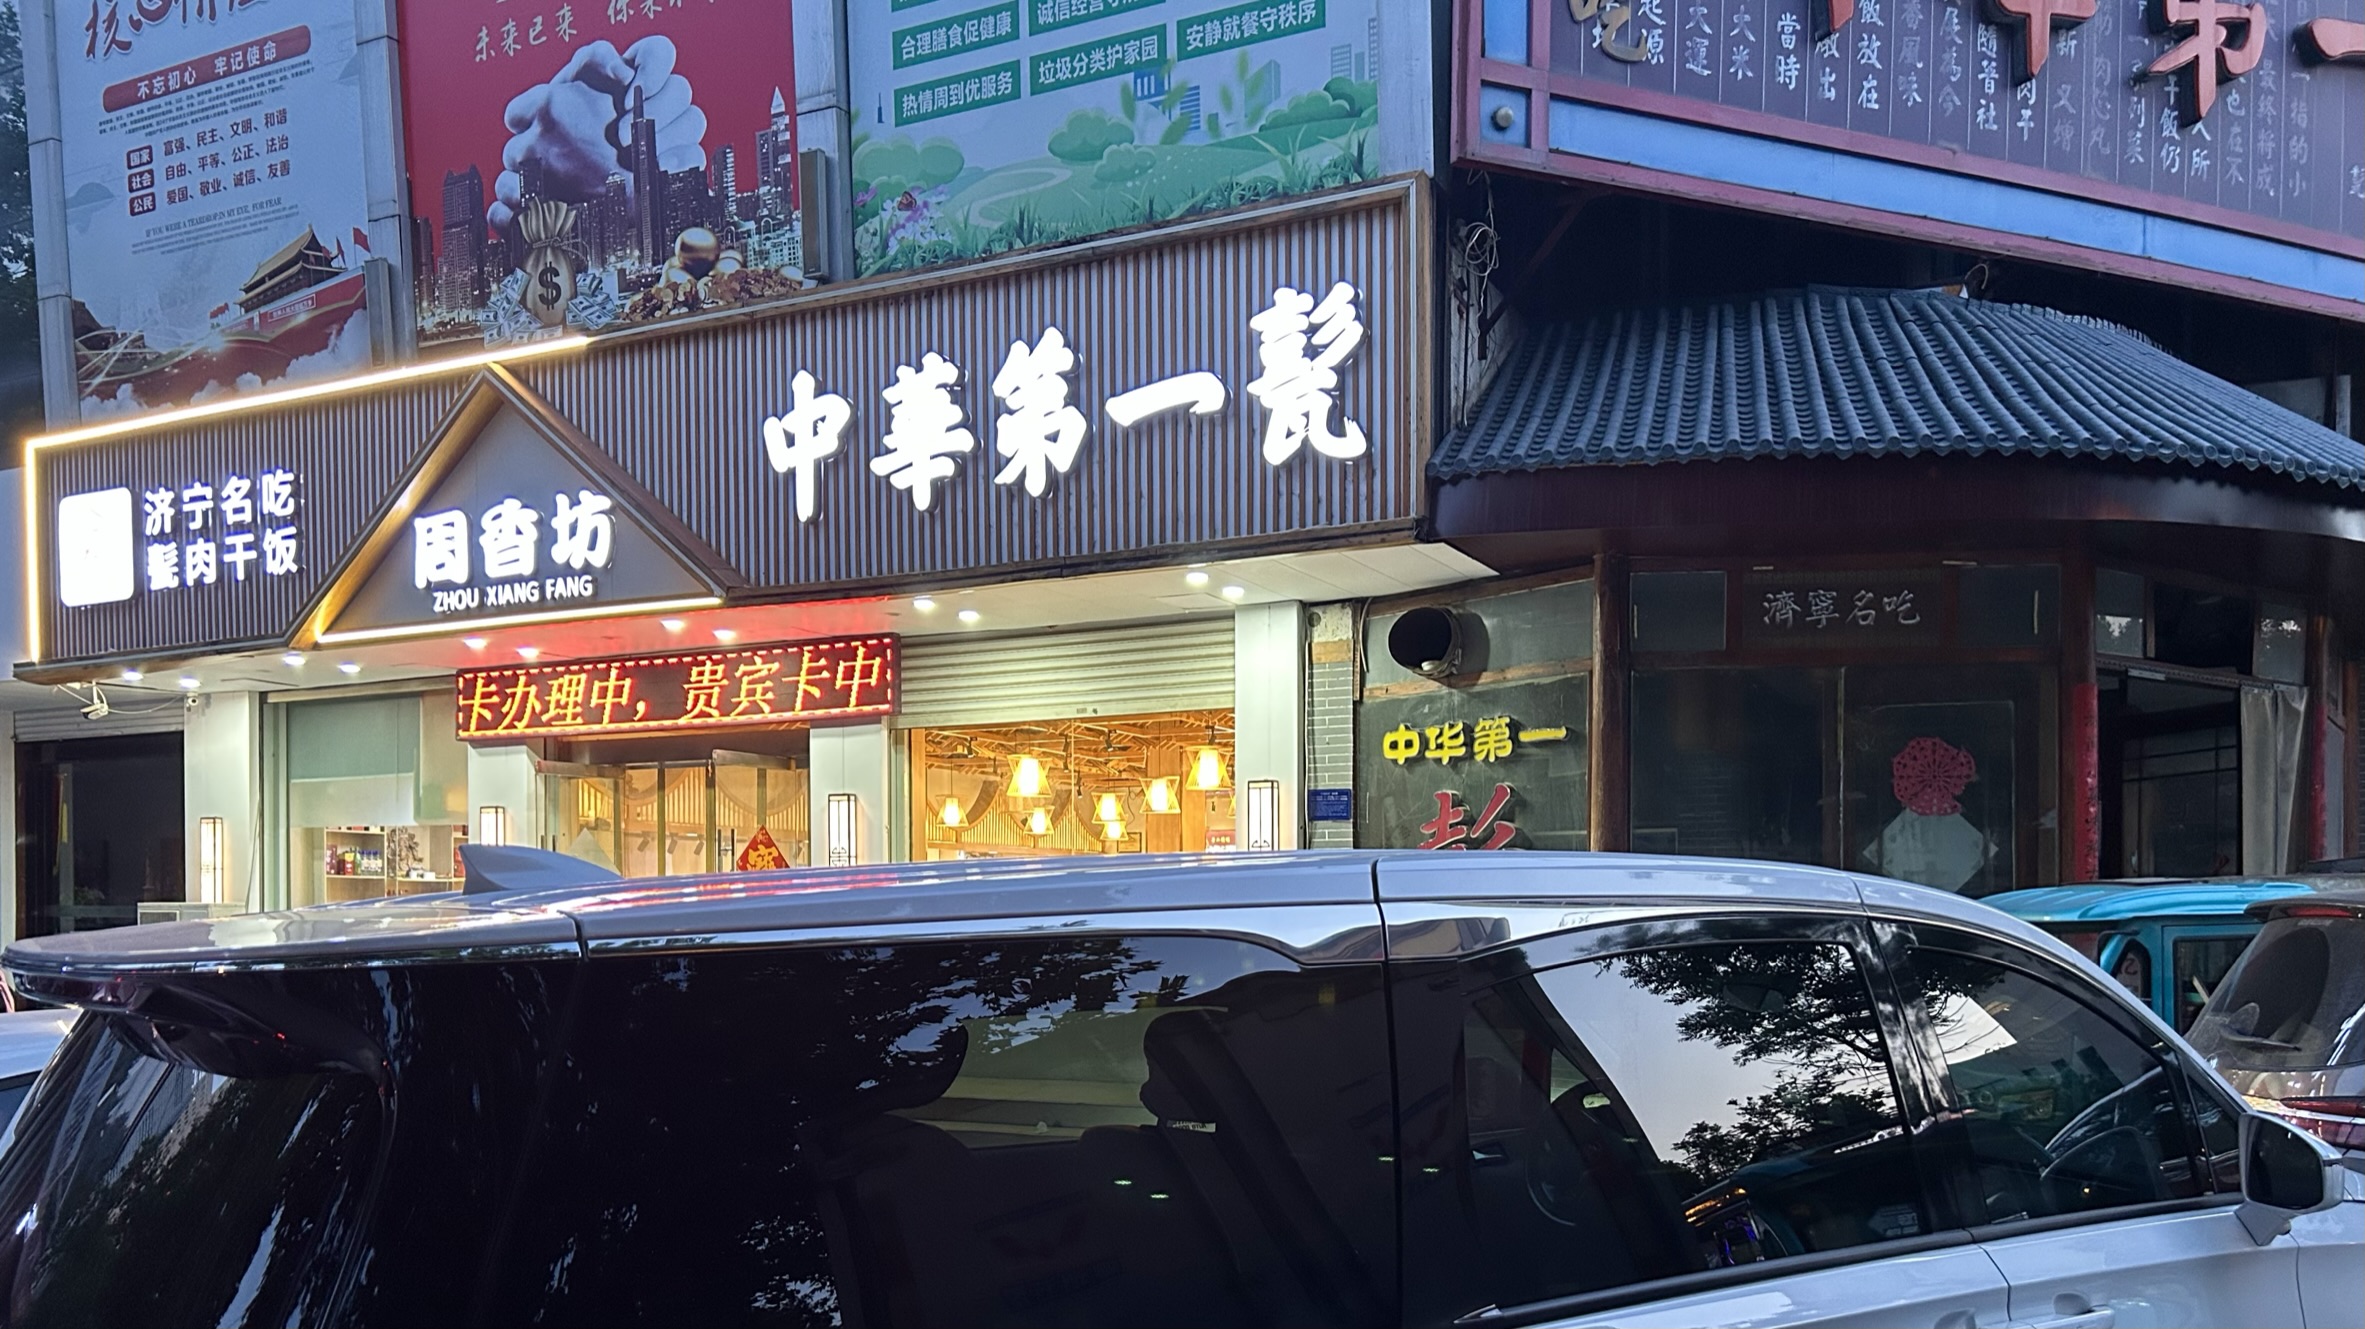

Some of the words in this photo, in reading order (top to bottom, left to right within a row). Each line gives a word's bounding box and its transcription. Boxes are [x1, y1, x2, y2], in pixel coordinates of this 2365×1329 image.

[475, 3, 577, 62] 未来已来
[901, 11, 1012, 60] 合理膳食促健康
[1037, 0, 1140, 25] 诚信经营
[1186, 0, 1316, 50] 安静就餐守秩序
[137, 67, 197, 100] 不忘初心
[214, 40, 277, 76] 牢记使命
[1038, 35, 1159, 85] 垃圾分类护家园
[1776, 12, 1801, 90] 當時
[902, 71, 1012, 117] 热情周到优服务
[131, 173, 152, 189] 社会
[133, 196, 154, 213] 公民
[144, 468, 296, 536] 济宁名吃
[413, 489, 612, 589] 周香坊
[433, 588, 479, 613] ZHOU
[486, 581, 539, 606] XIANG
[545, 575, 593, 600] FANG
[1763, 589, 1920, 629] 濟寧名吃
[1382, 715, 1568, 765] 中华第一
